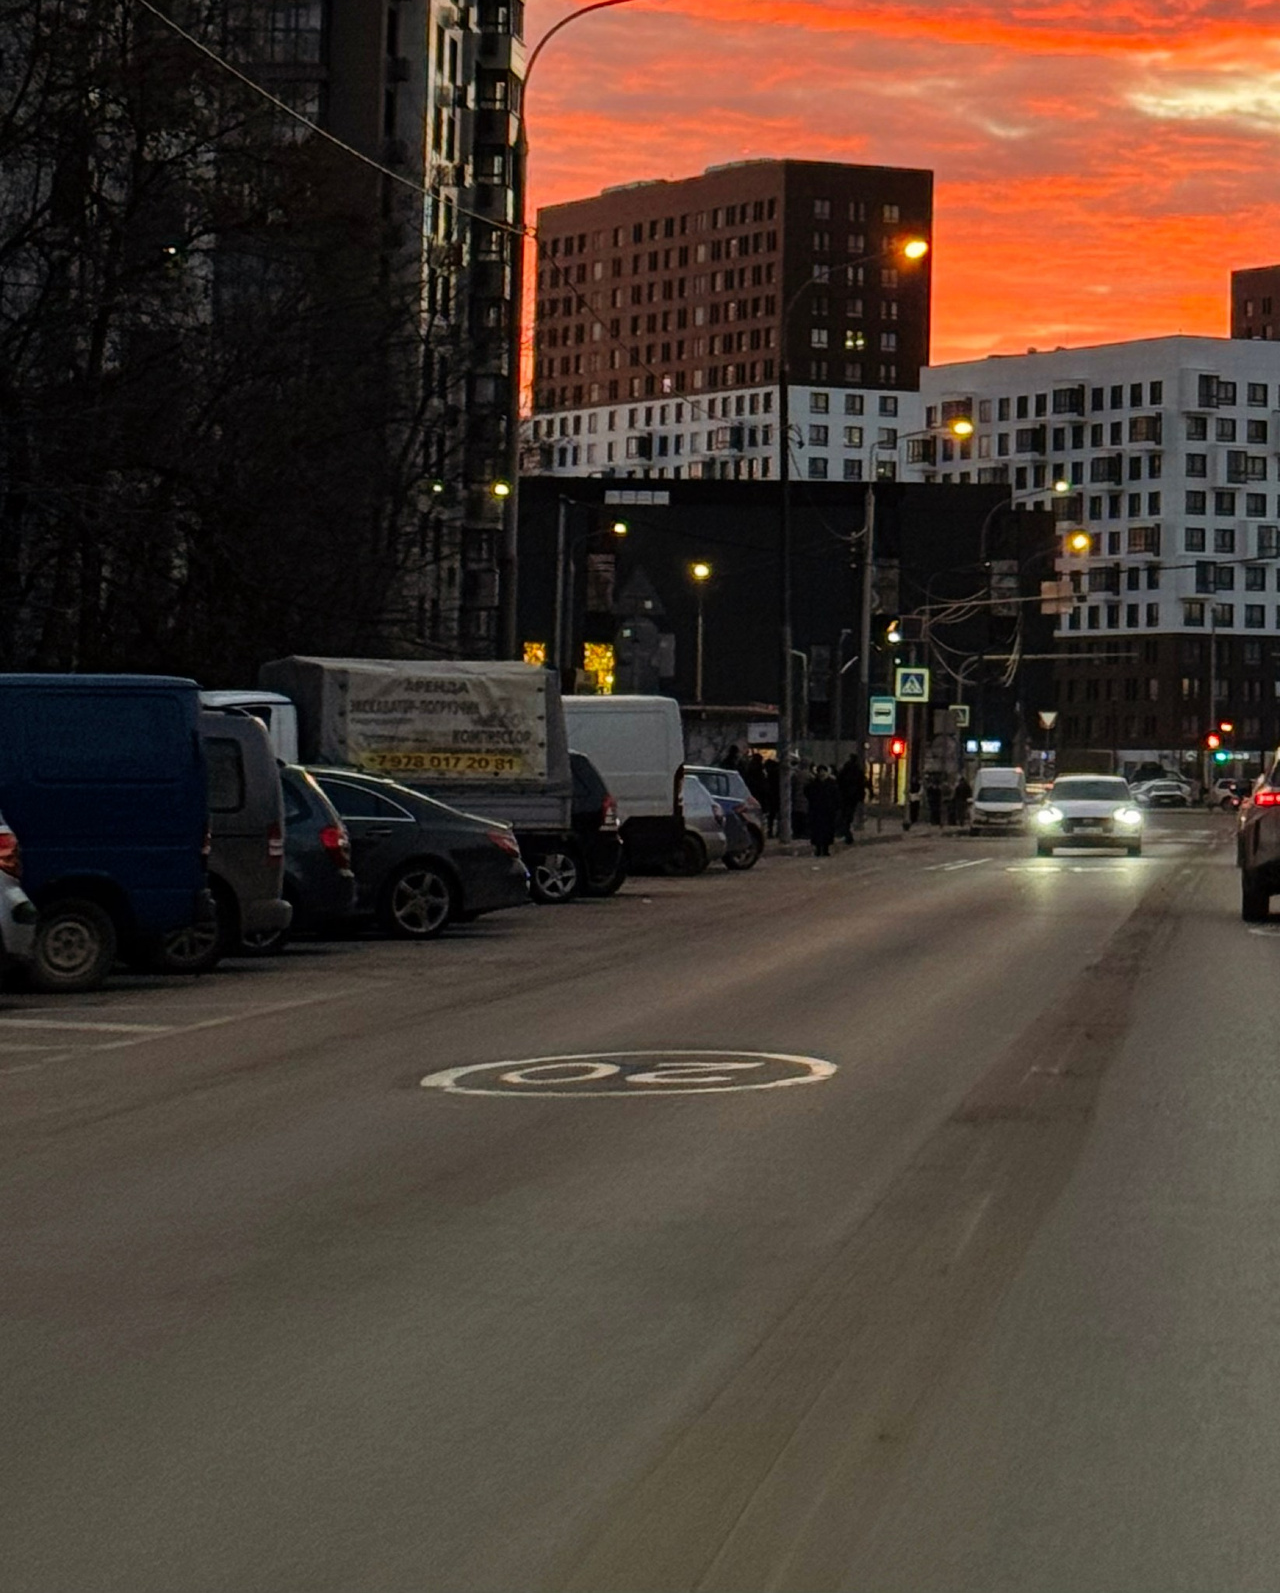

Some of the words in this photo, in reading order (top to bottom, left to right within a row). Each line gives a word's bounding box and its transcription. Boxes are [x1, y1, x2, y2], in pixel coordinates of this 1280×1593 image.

[404, 681, 469, 694] АРЕНДА
[391, 756, 425, 769] 978
[430, 756, 461, 769] 017
[467, 757, 490, 769] 20
[495, 758, 514, 770] 81
